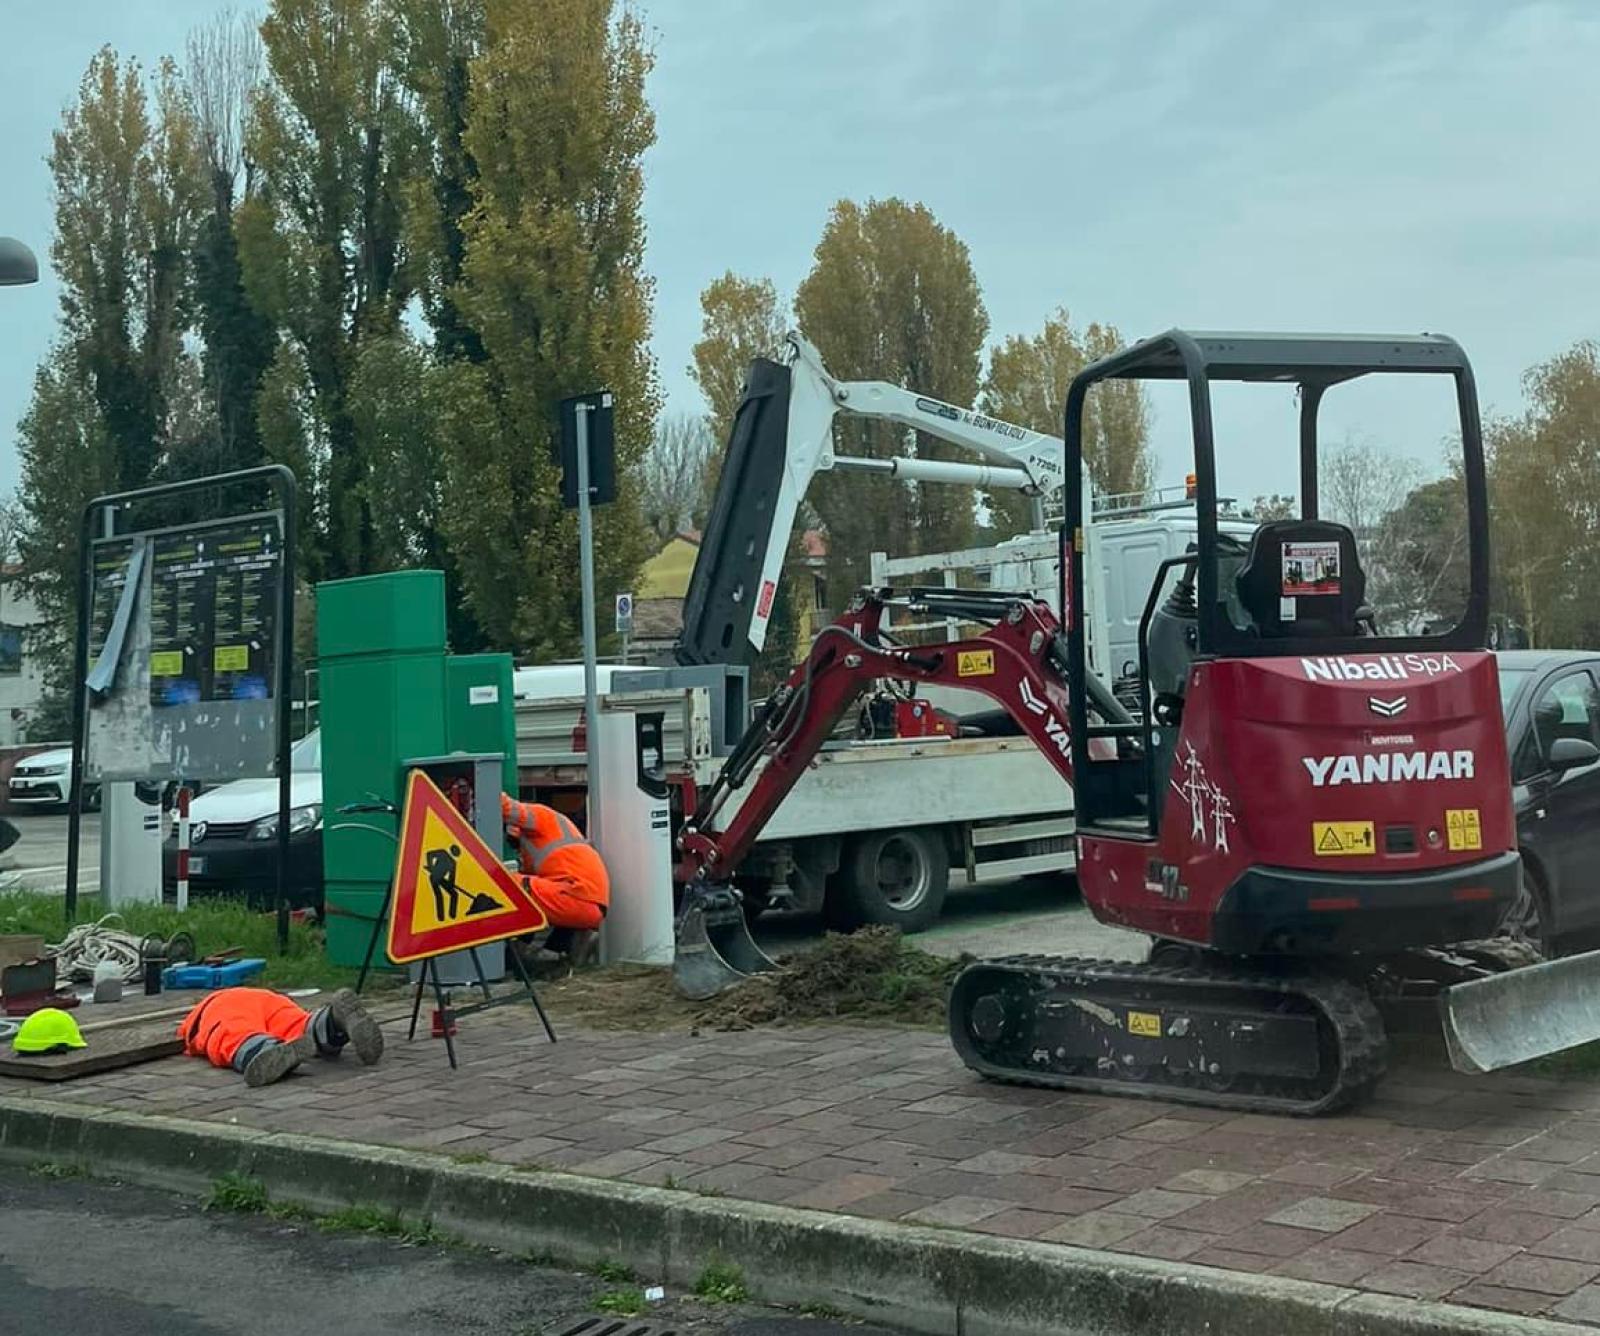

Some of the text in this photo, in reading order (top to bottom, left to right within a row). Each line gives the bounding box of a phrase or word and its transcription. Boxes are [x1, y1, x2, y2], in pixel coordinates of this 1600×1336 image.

[1301, 653, 1462, 681] Nibali SpA
[1302, 750, 1476, 787] YANMAR
